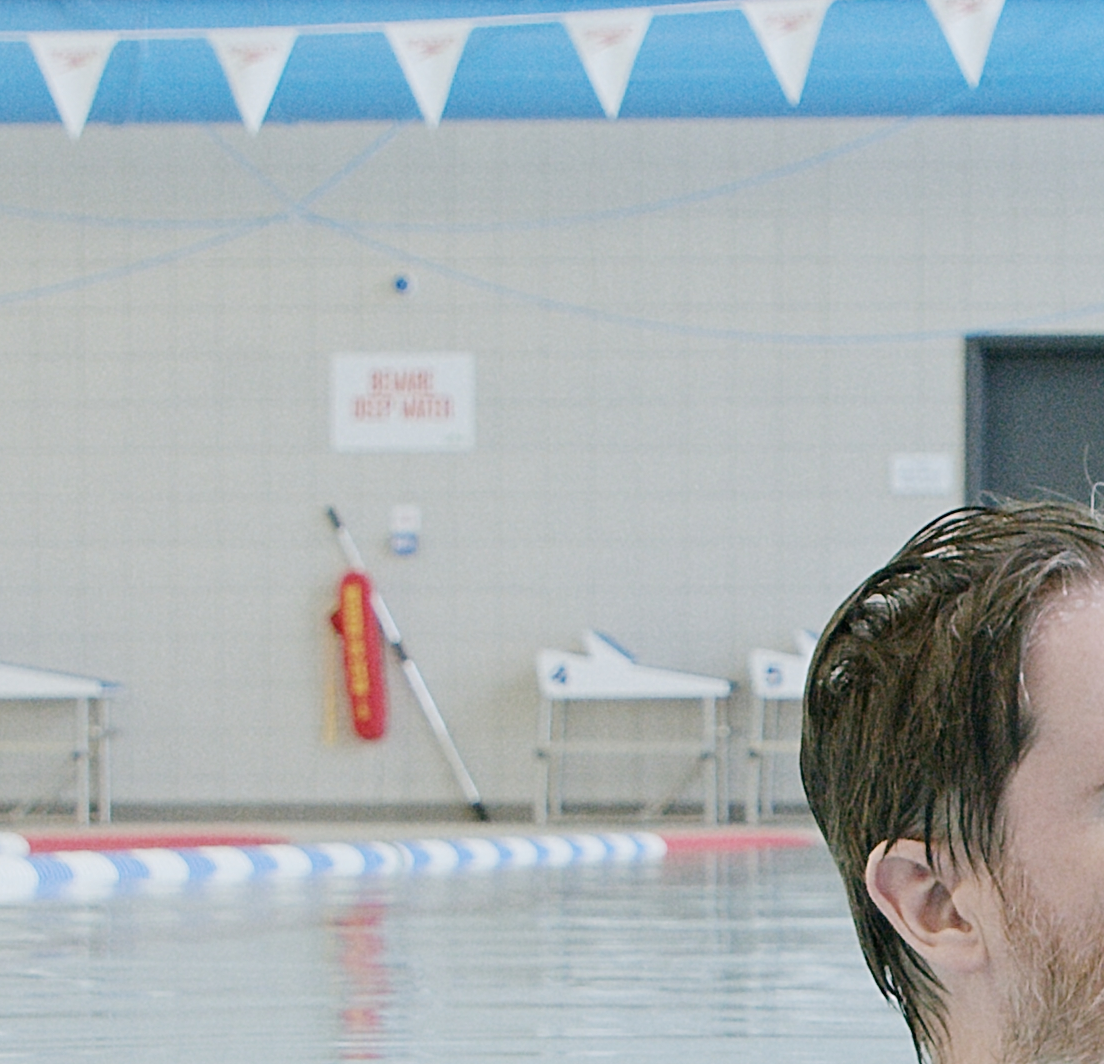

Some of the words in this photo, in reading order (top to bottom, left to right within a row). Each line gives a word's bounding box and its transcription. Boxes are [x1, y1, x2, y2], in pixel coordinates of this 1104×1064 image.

[369, 370, 434, 392] BEWARE
[352, 394, 391, 419] DEEP
[399, 394, 455, 419] WATER
[551, 664, 567, 684] 4
